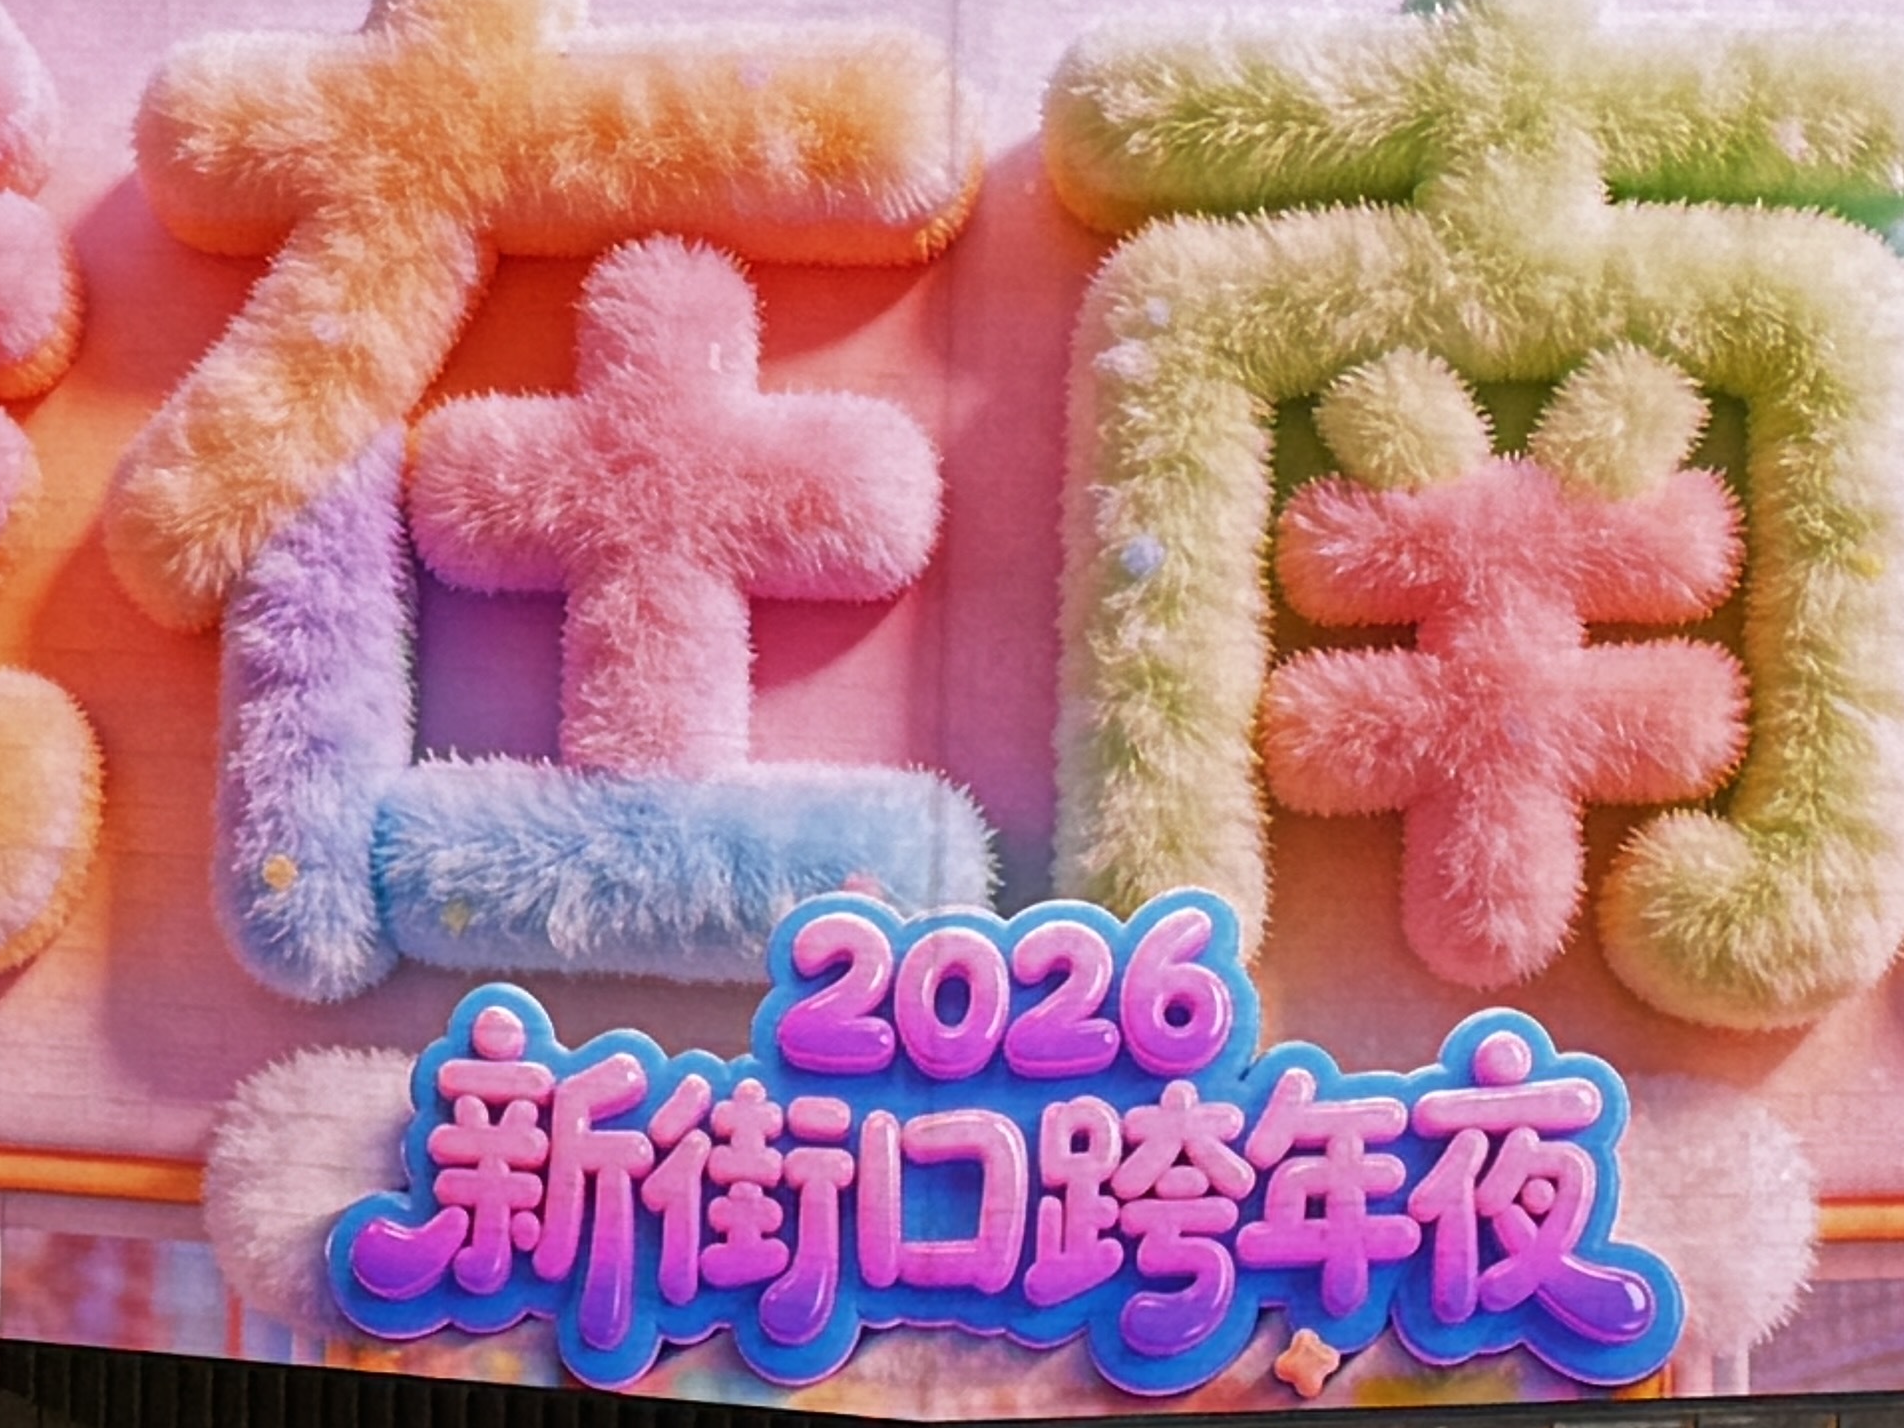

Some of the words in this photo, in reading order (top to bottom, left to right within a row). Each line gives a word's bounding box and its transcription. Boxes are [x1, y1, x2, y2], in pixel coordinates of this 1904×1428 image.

[776, 901, 1240, 1076] 2026
[350, 1005, 1658, 1350] 新街口跨年夜
